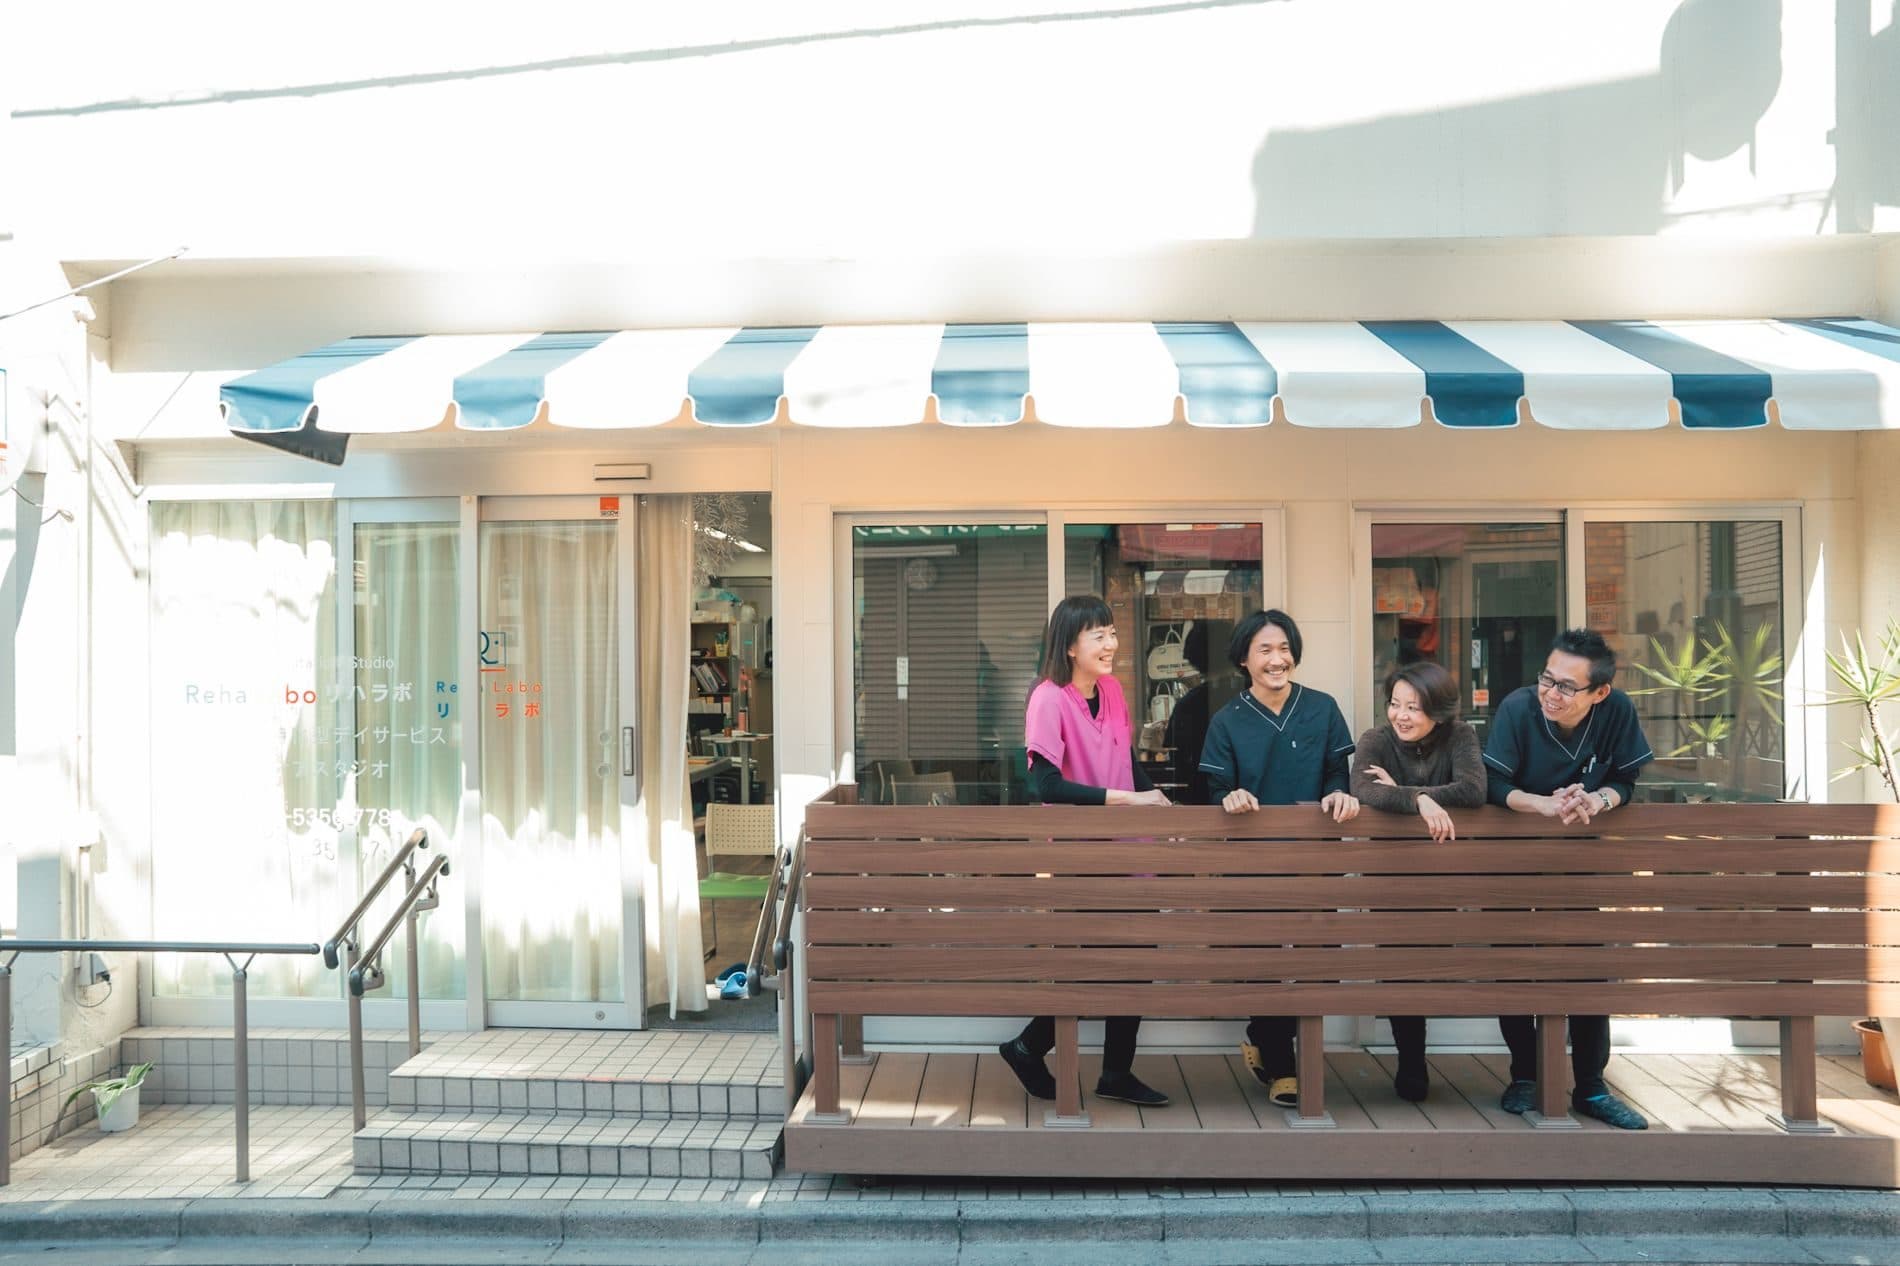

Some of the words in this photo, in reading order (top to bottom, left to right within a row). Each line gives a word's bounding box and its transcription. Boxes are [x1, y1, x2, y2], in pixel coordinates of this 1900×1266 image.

[351, 655, 395, 670] Studio
[185, 684, 248, 704] Reha
[493, 680, 541, 693] Labo
